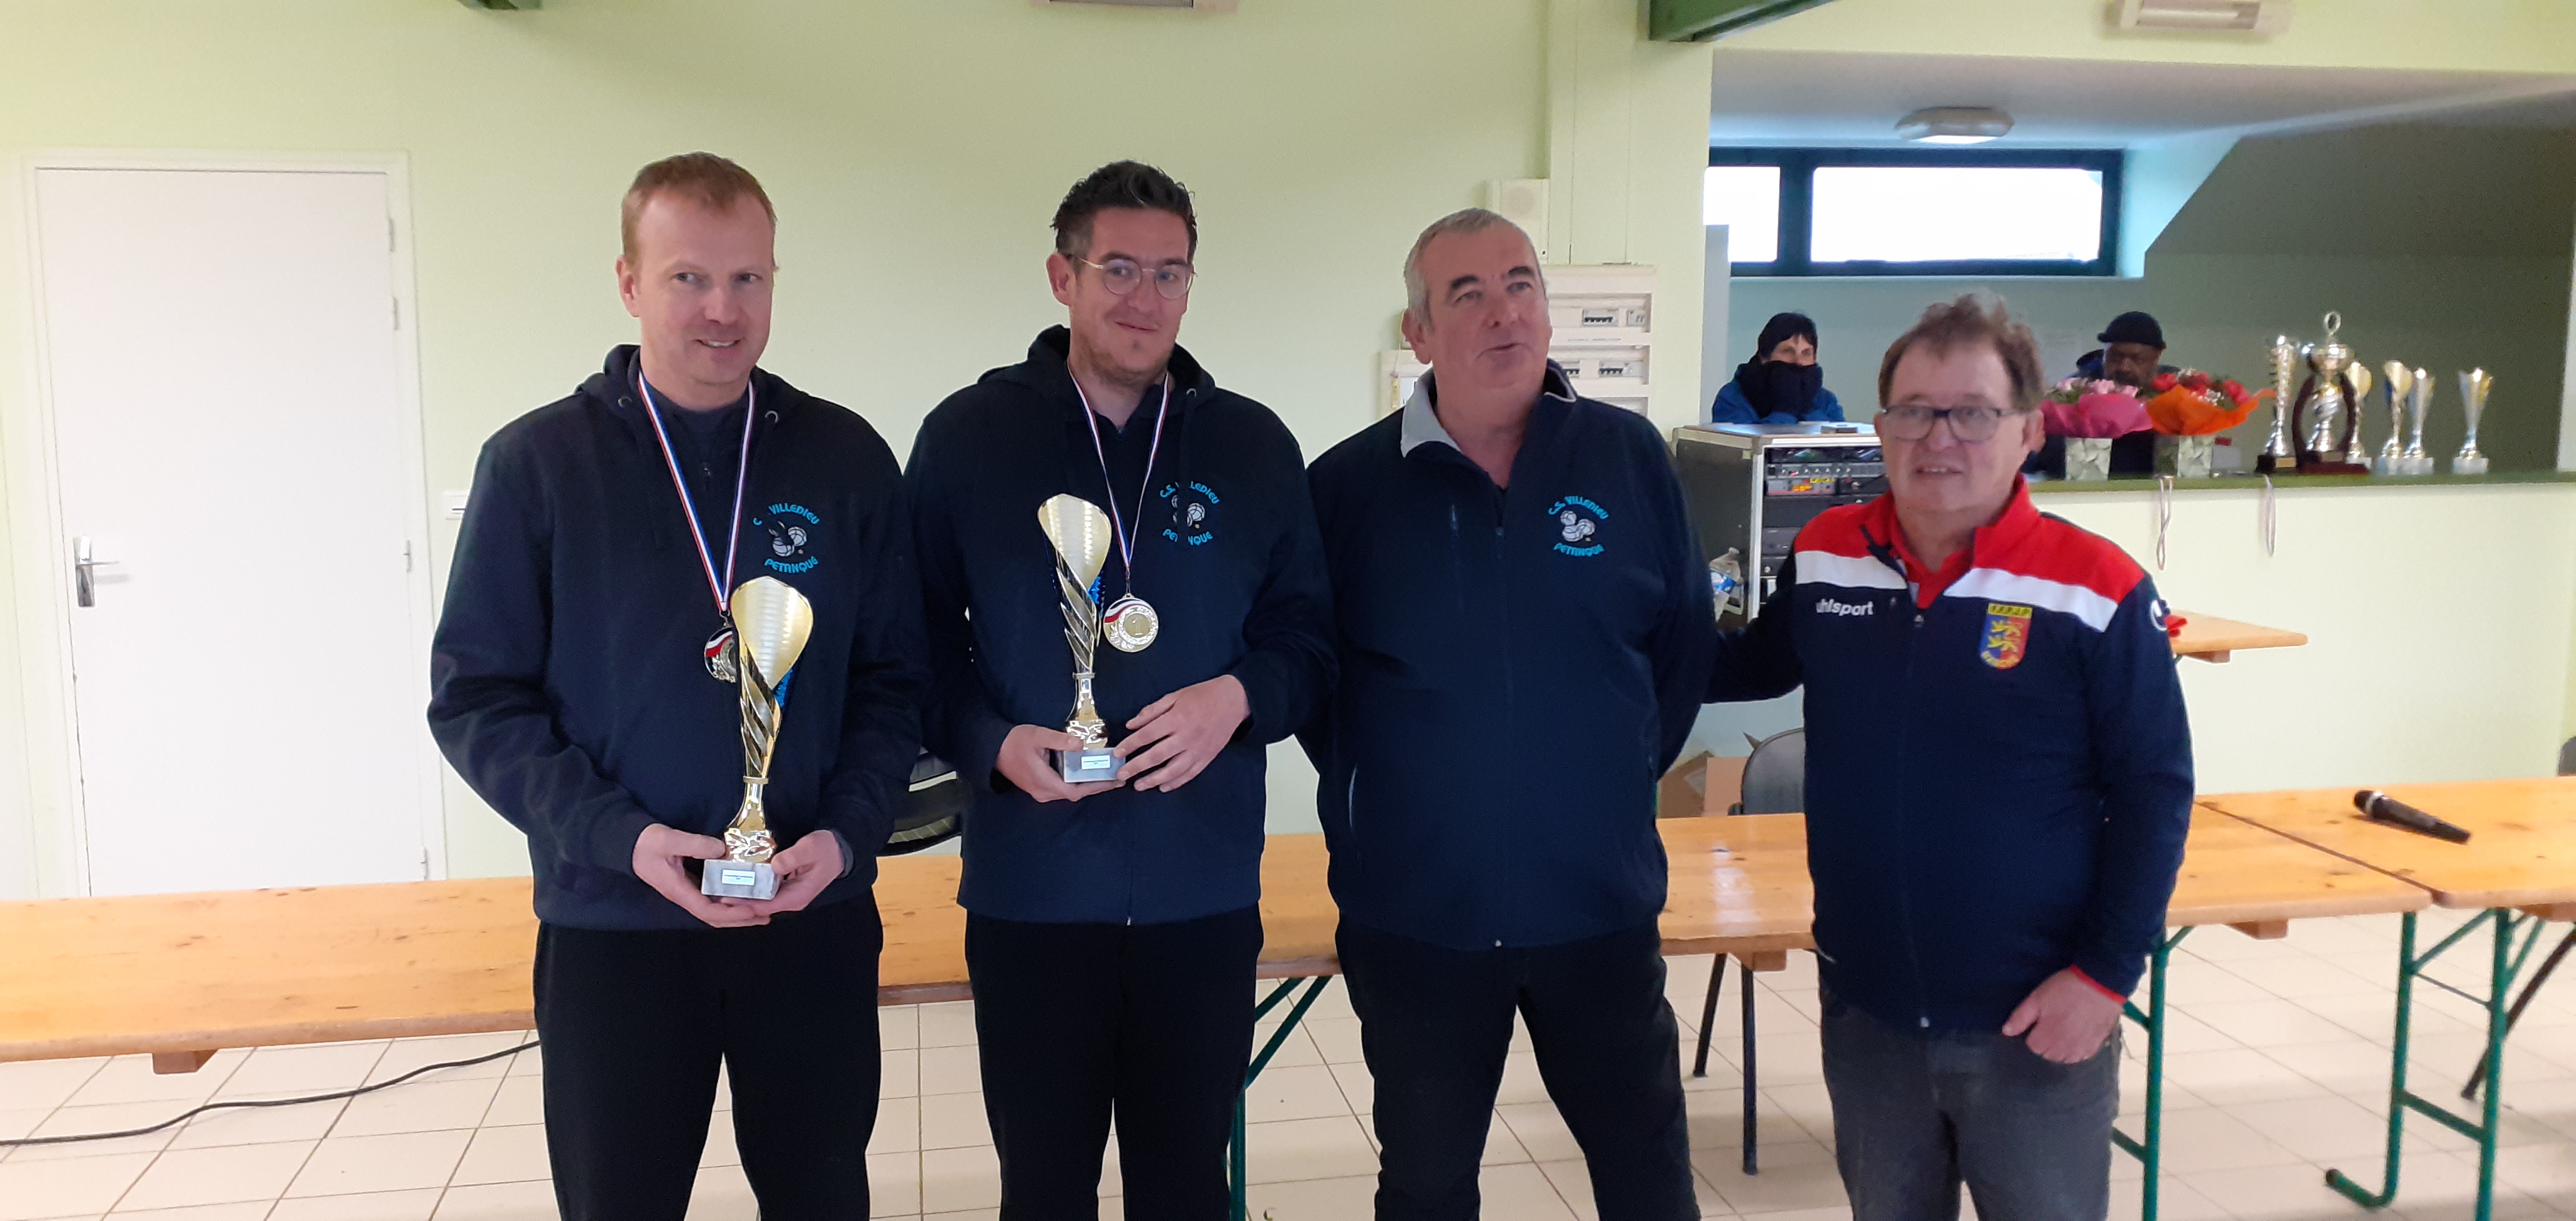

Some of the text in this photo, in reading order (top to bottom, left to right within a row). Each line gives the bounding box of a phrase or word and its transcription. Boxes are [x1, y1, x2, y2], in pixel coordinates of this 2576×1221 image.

[768, 503, 821, 524] VILLEDIEU
[1162, 529, 1213, 546] PETNQUE
[764, 556, 819, 573] PETANQUE
